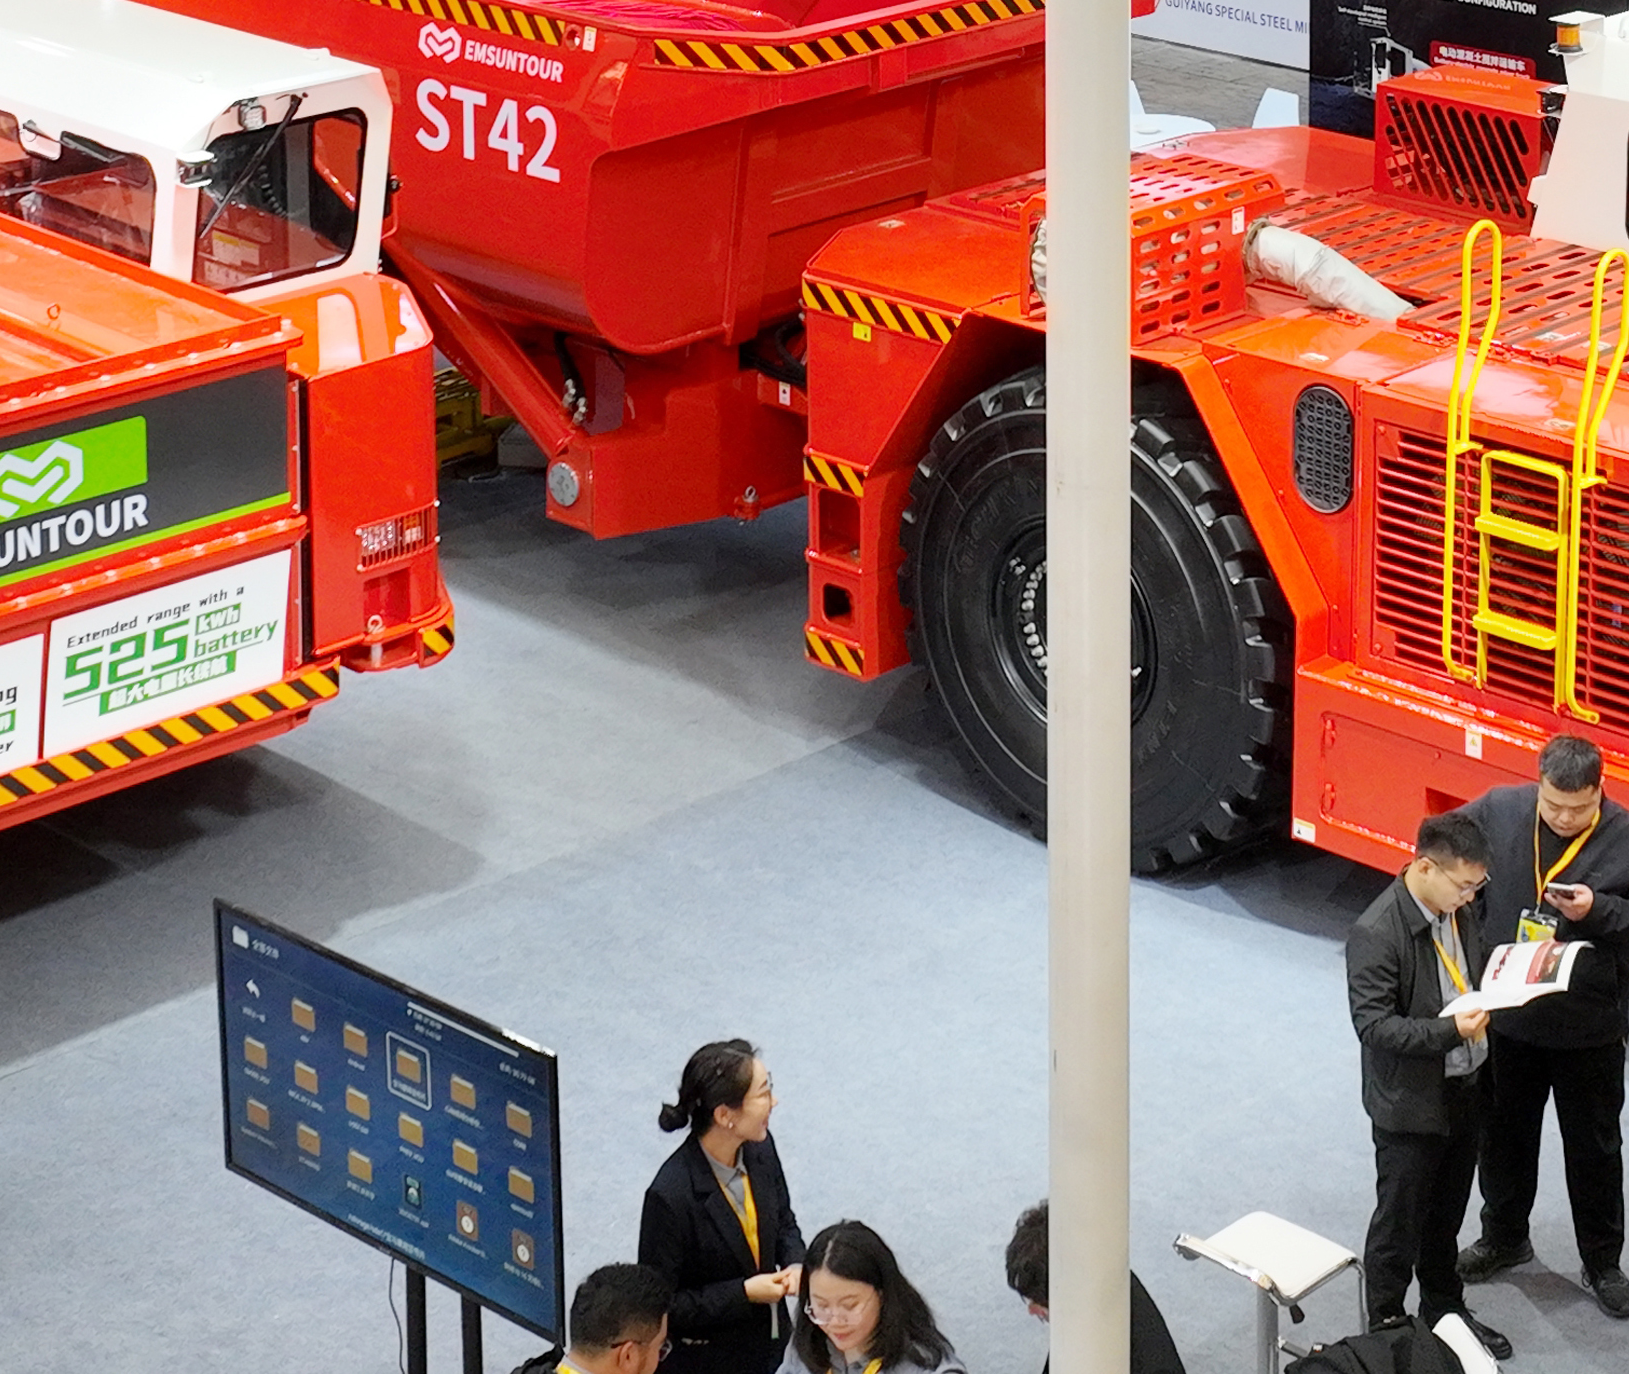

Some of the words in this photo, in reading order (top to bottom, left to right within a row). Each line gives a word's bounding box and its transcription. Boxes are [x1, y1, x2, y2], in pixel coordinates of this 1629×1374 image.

[1215, 3, 1258, 25] SPECIAL
[1259, 12, 1293, 32] STEEL
[463, 38, 565, 84] EMSUNTOUR
[414, 77, 561, 184] ST42
[66, 615, 139, 649] Extended
[146, 599, 192, 626] range
[199, 589, 229, 610] with
[235, 585, 246, 597] a
[193, 618, 280, 662] battery
[62, 616, 192, 701] 525
[194, 601, 242, 636] kWh
